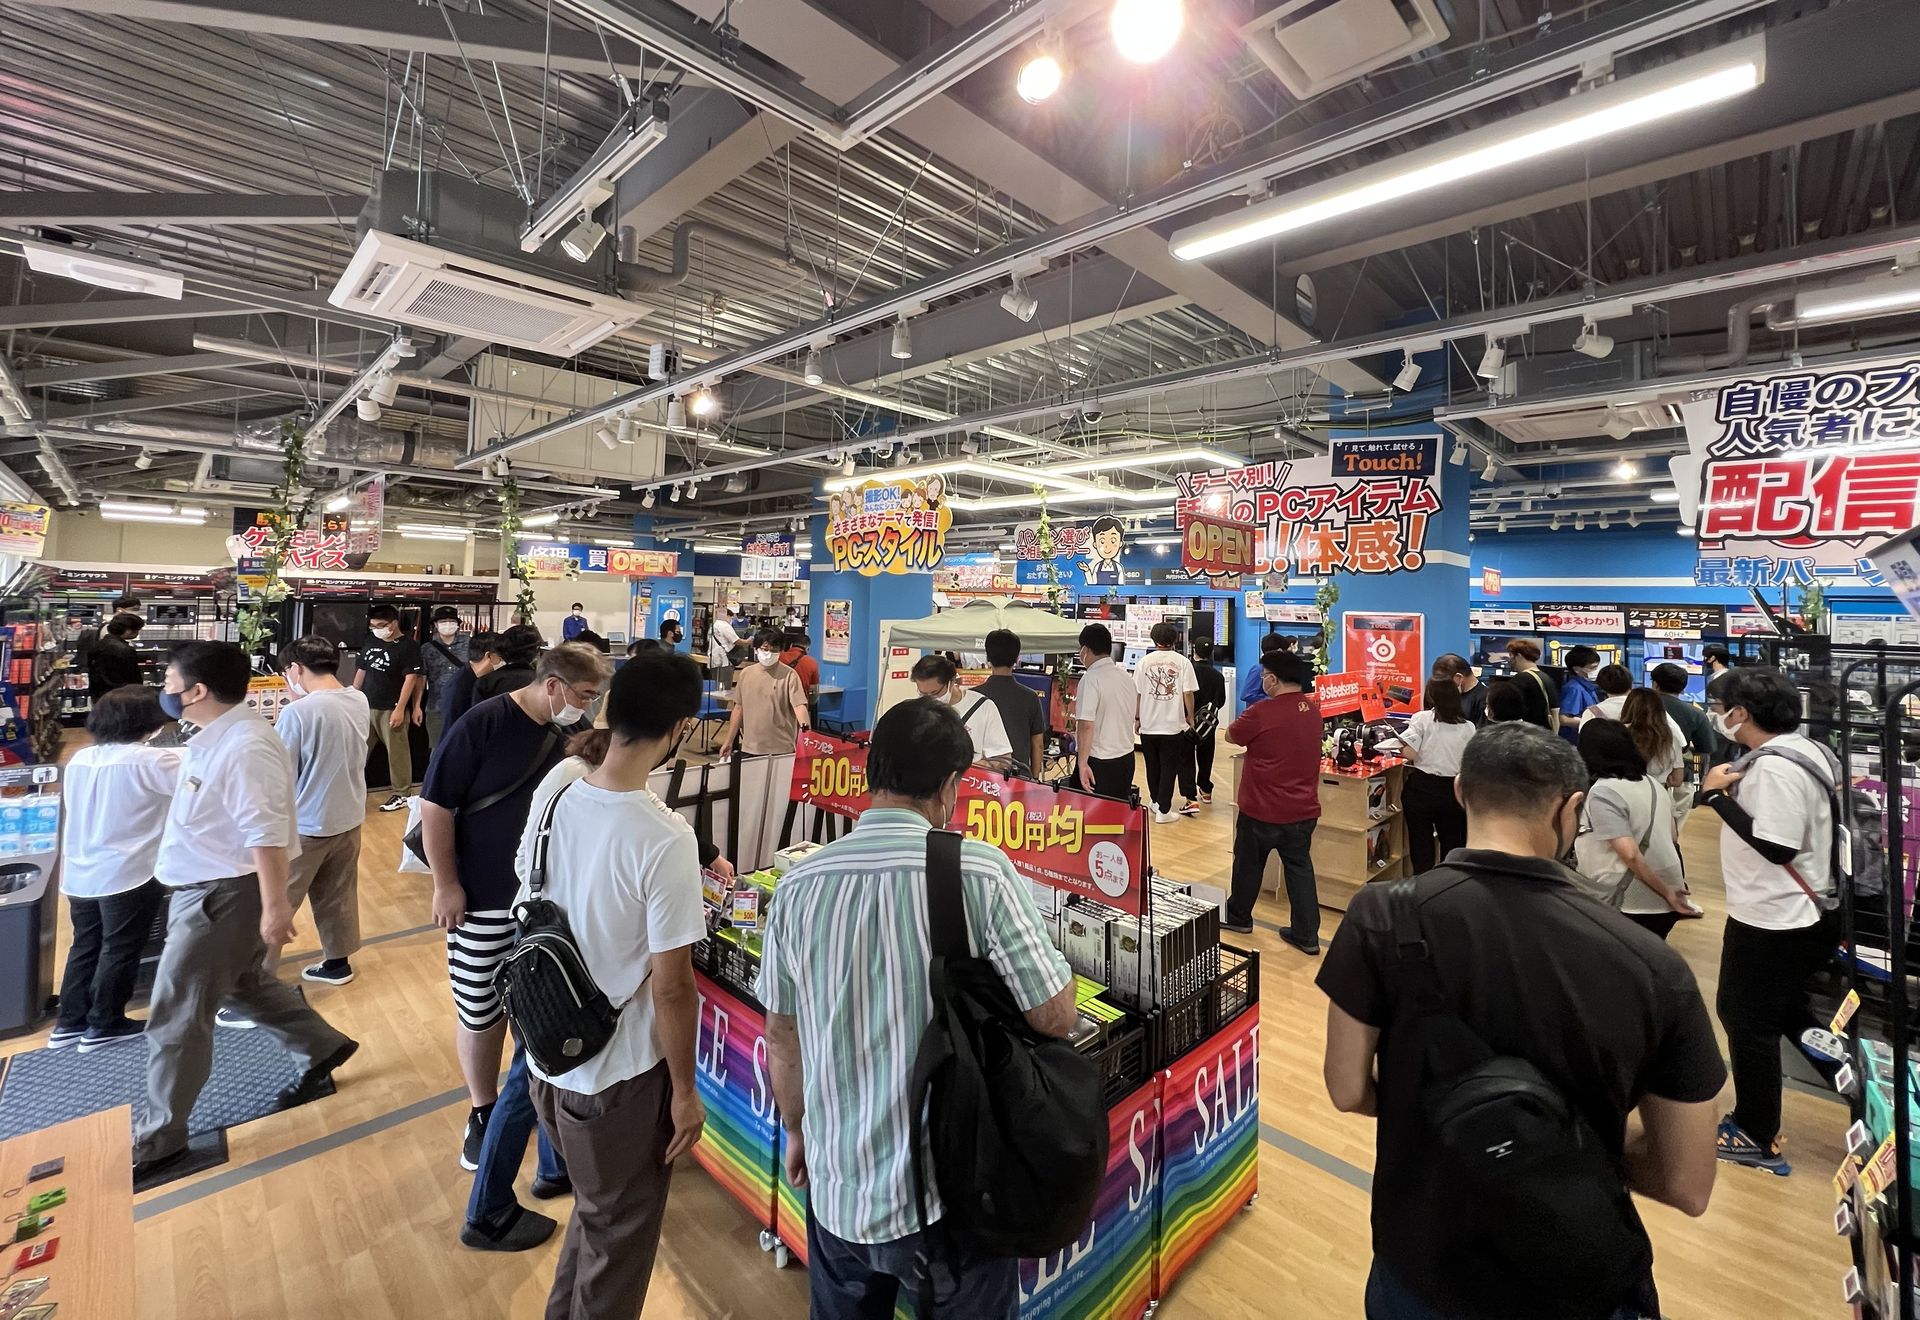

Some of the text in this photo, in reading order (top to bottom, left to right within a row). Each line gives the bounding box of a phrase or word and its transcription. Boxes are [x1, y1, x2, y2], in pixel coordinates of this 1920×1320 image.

[1724, 366, 1920, 415] 自慢のプ
[1712, 406, 1920, 453] 人気者に
[1344, 453, 1423, 471] Touch!
[1191, 463, 1275, 494] テーマ別!
[865, 487, 900, 502] 撮影OK!
[1177, 479, 1440, 529] 話のPCアイテム
[1705, 452, 1917, 535] 配信
[834, 511, 939, 536] さまざまなテーマで発信!
[1018, 527, 1090, 546] パン選び
[832, 526, 943, 572] PCスタイル
[1188, 520, 1252, 567] OPEN
[588, 549, 608, 567] 買
[612, 552, 675, 573] OPEN
[1562, 616, 1619, 627] まるわかり!
[1629, 610, 1719, 620] ゲーミングモニター
[1325, 682, 1359, 700] steelseries
[809, 756, 869, 798] 500円
[961, 775, 1001, 797] ープン記念
[965, 799, 1126, 854] 500円均一
[695, 991, 729, 1089] LE
